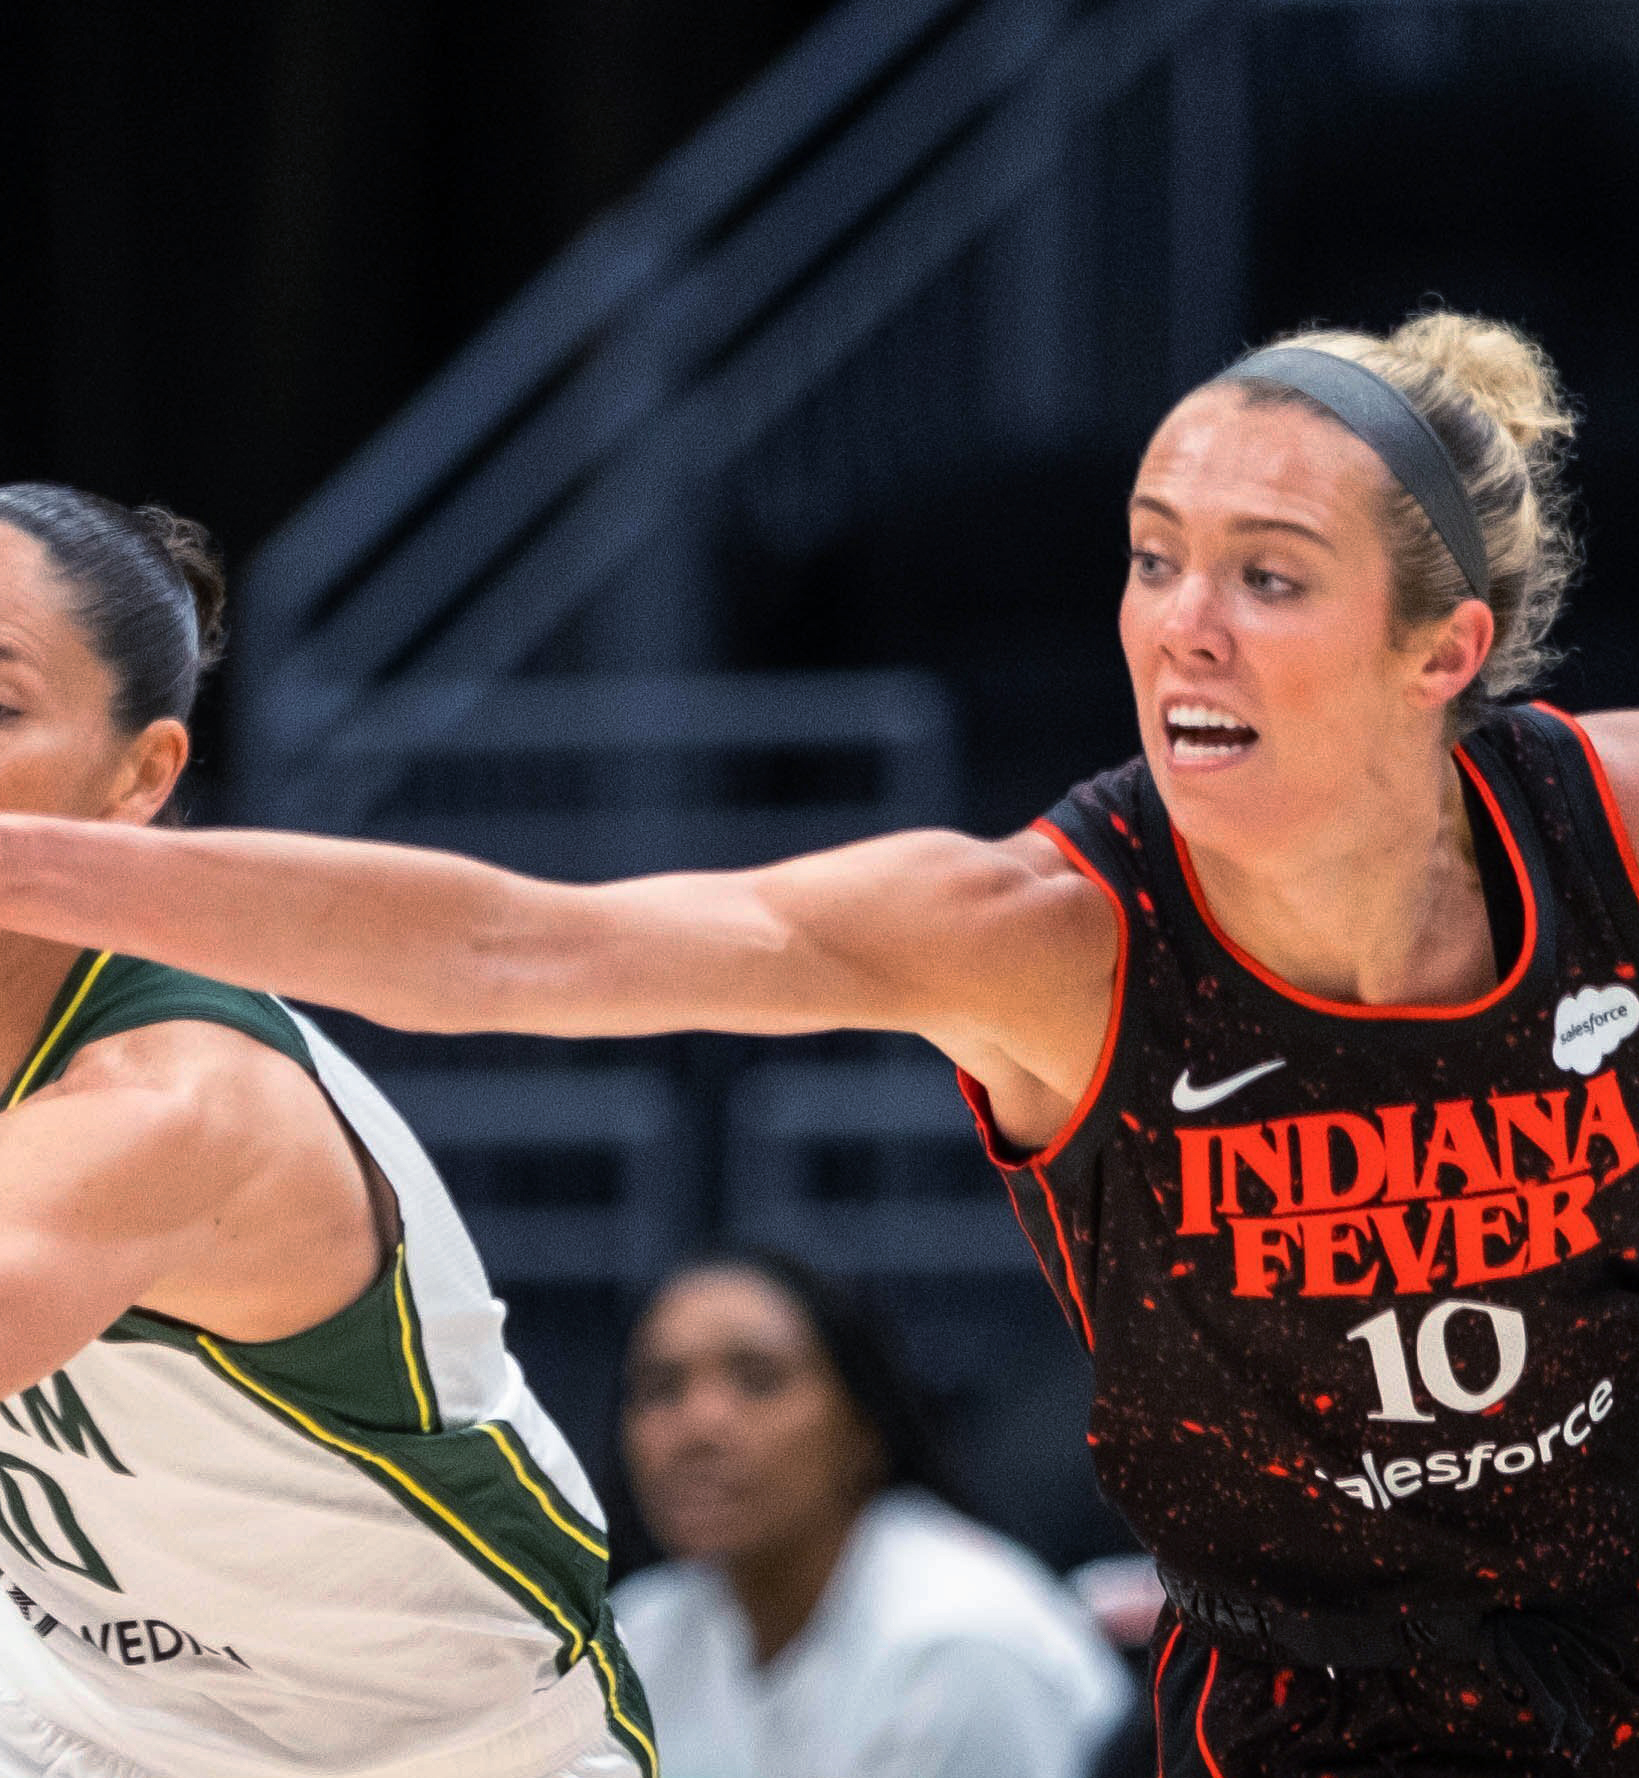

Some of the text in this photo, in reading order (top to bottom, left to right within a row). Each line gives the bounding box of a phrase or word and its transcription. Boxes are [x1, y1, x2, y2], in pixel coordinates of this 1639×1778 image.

[1559, 1004, 1628, 1046] salesforce
[1227, 1175, 1602, 1299] FEVER
[1346, 1298, 1528, 1423] 10
[1313, 1378, 1614, 1511] alesforce
